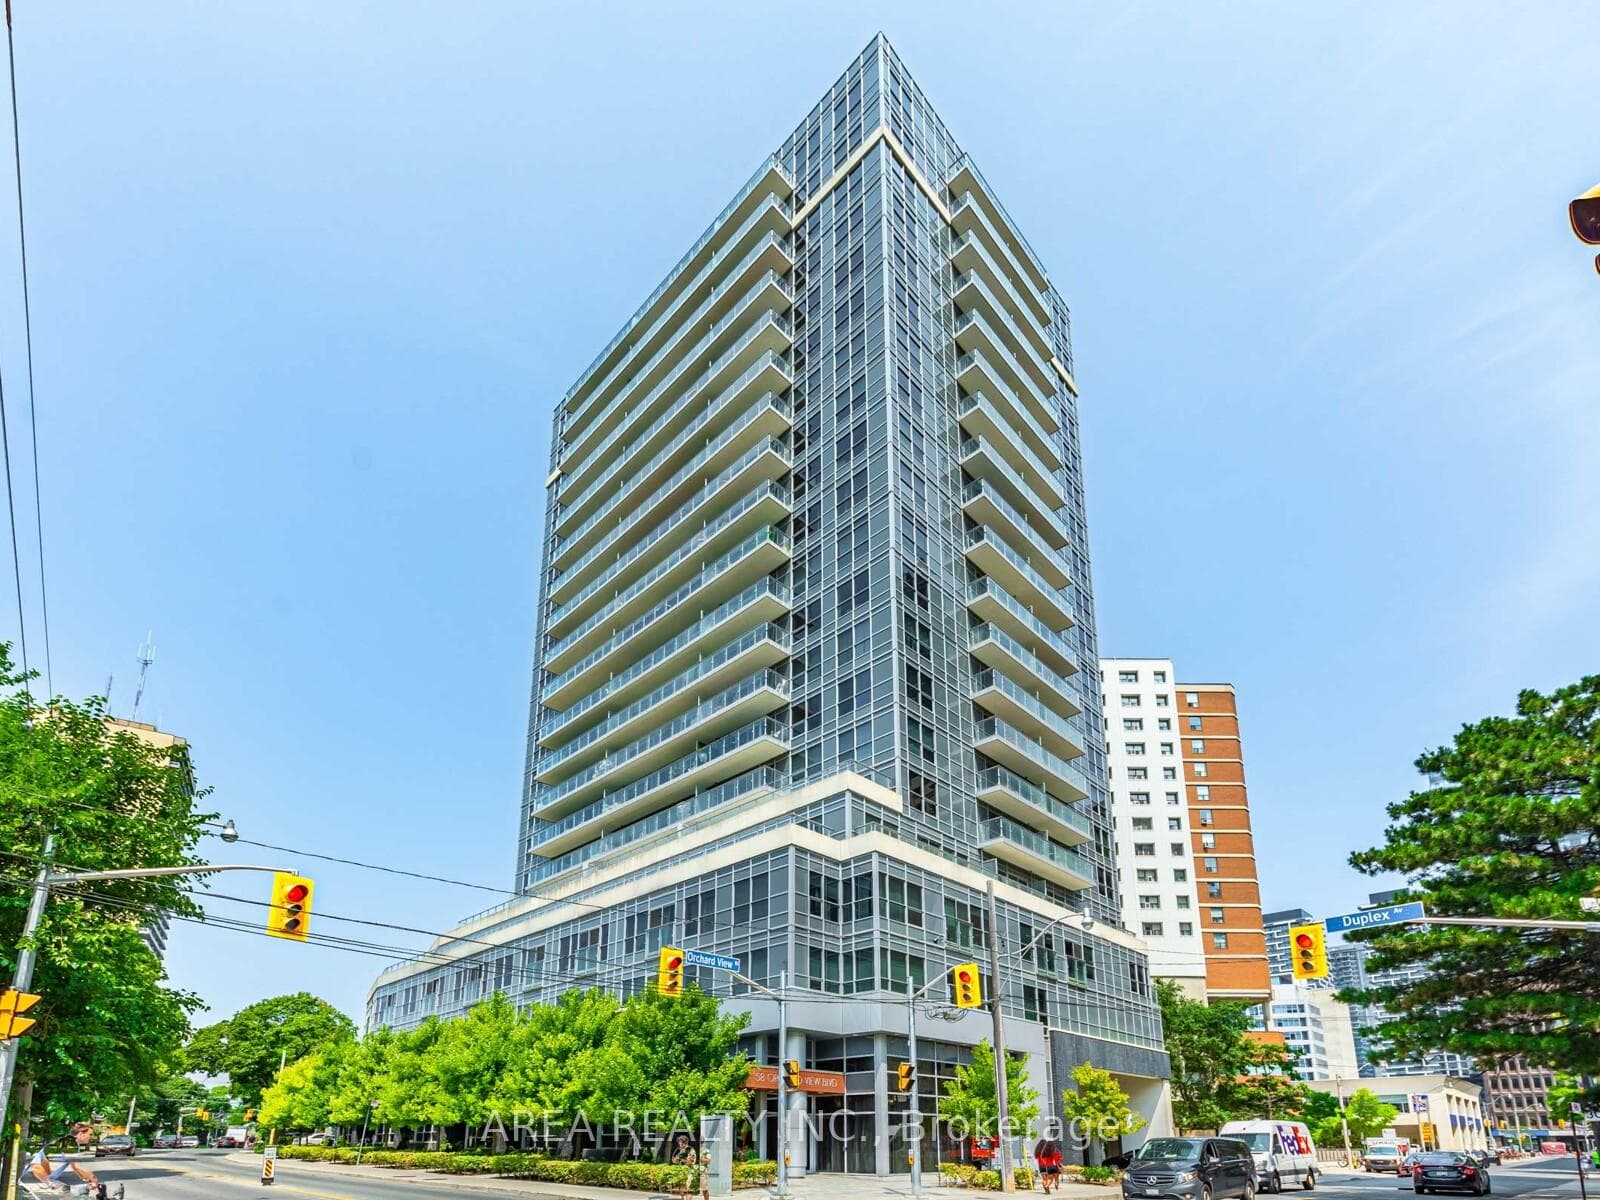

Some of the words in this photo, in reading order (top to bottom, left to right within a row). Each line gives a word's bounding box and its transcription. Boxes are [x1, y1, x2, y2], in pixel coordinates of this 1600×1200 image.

[1342, 911, 1390, 926] Duplex
[687, 952, 716, 966] Orchard
[716, 957, 733, 969] View
[804, 1076, 821, 1086] VIEW
[821, 1078, 838, 1088] BLVD
[1276, 1125, 1312, 1155] FedEx
